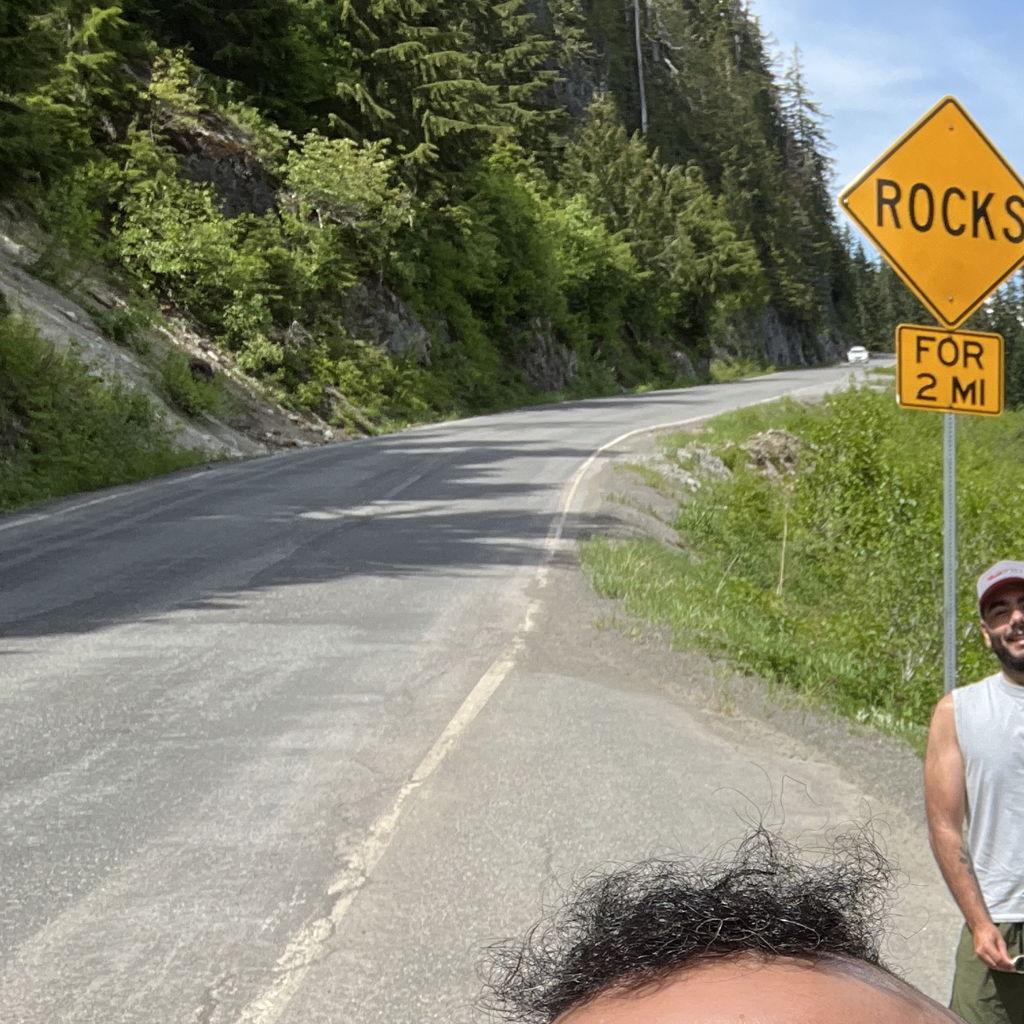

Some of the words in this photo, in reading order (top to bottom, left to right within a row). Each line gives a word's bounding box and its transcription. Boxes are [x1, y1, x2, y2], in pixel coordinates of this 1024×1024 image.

[916, 336, 984, 370] FOR
[916, 373, 938, 402] 2
[951, 376, 985, 406] MI
